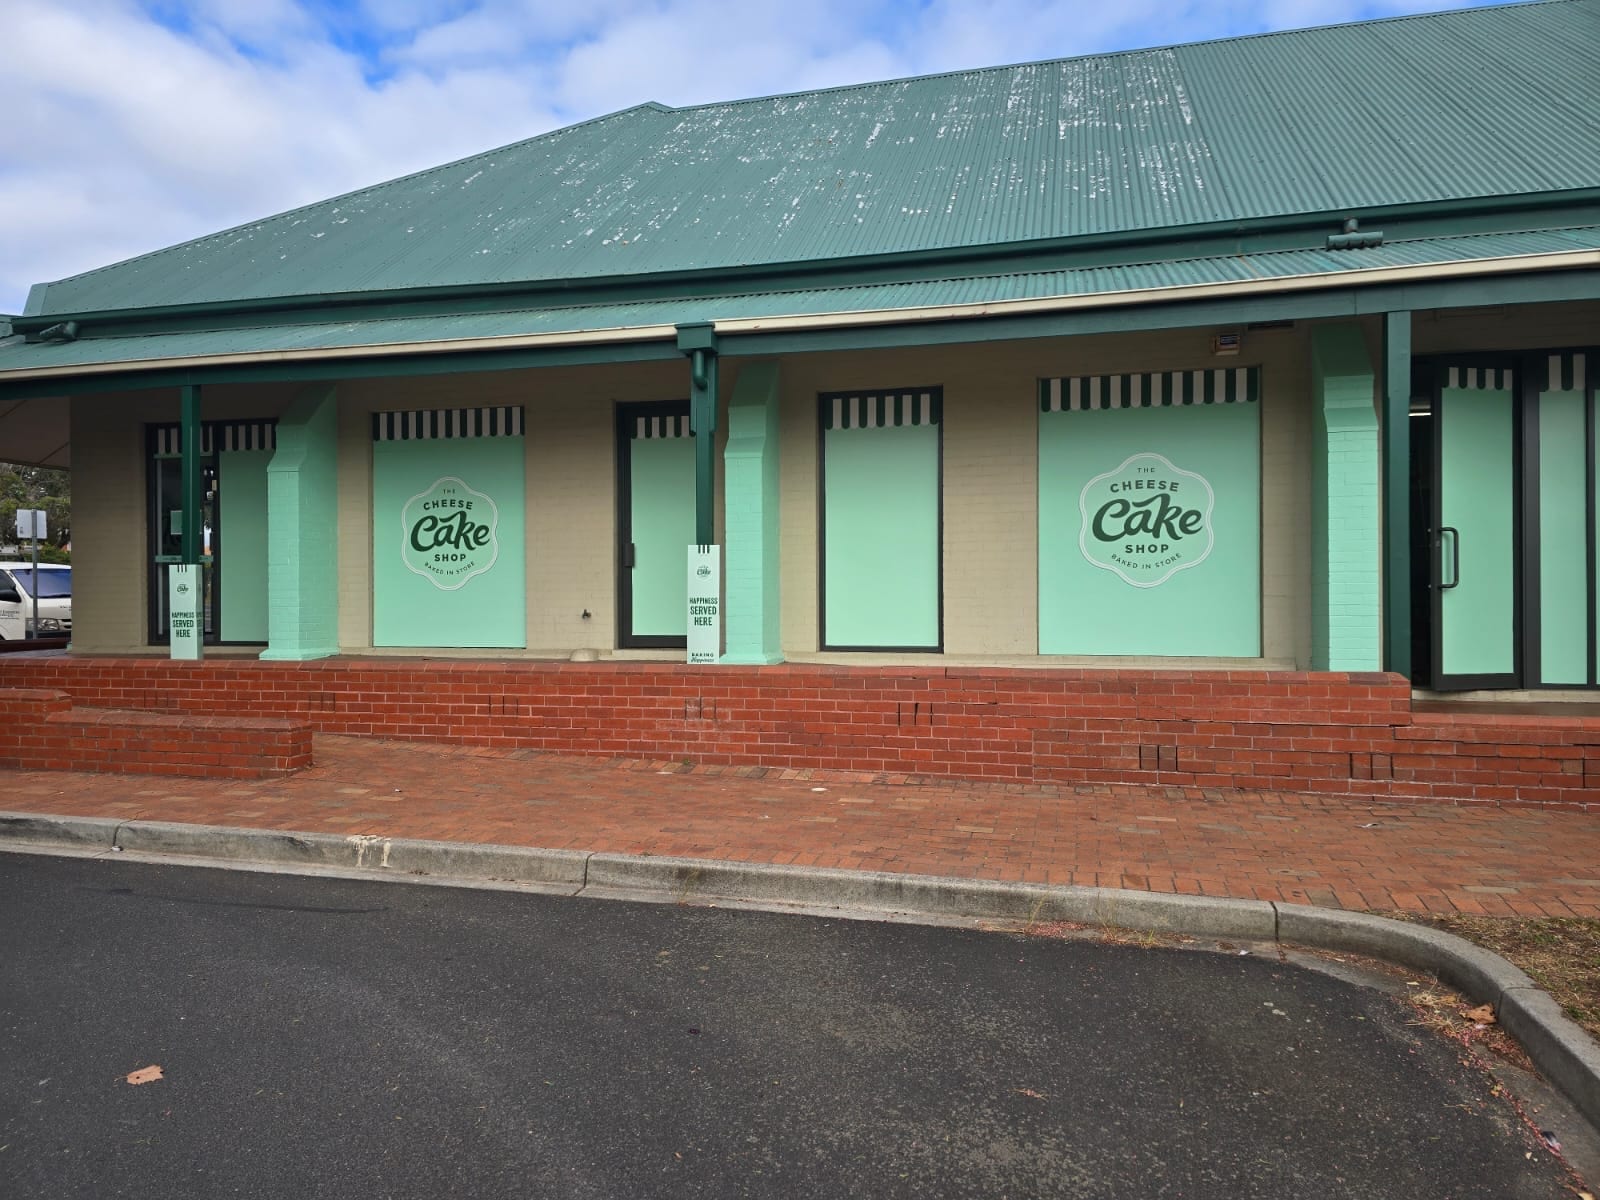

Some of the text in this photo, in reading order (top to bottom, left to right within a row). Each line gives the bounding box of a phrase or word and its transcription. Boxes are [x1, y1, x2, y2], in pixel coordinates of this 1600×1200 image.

[1110, 479, 1180, 493] CHEESE
[423, 498, 473, 511] CHEESE
[1092, 493, 1203, 542] Cake
[410, 510, 490, 552] Cake
[1125, 544, 1169, 553] SHOP
[434, 553, 467, 562] SHOP
[1111, 553, 1138, 569] BAKED
[1155, 552, 1182, 568] STORE
[424, 562, 444, 575] BAKED
[456, 561, 475, 575] STORE
[689, 597, 718, 605] HAPPINESS
[171, 611, 194, 619] HAPPINESS
[690, 605, 717, 615] SERVED
[172, 619, 194, 628] SERVED
[694, 616, 713, 626] HERE
[175, 629, 191, 638] HERE
